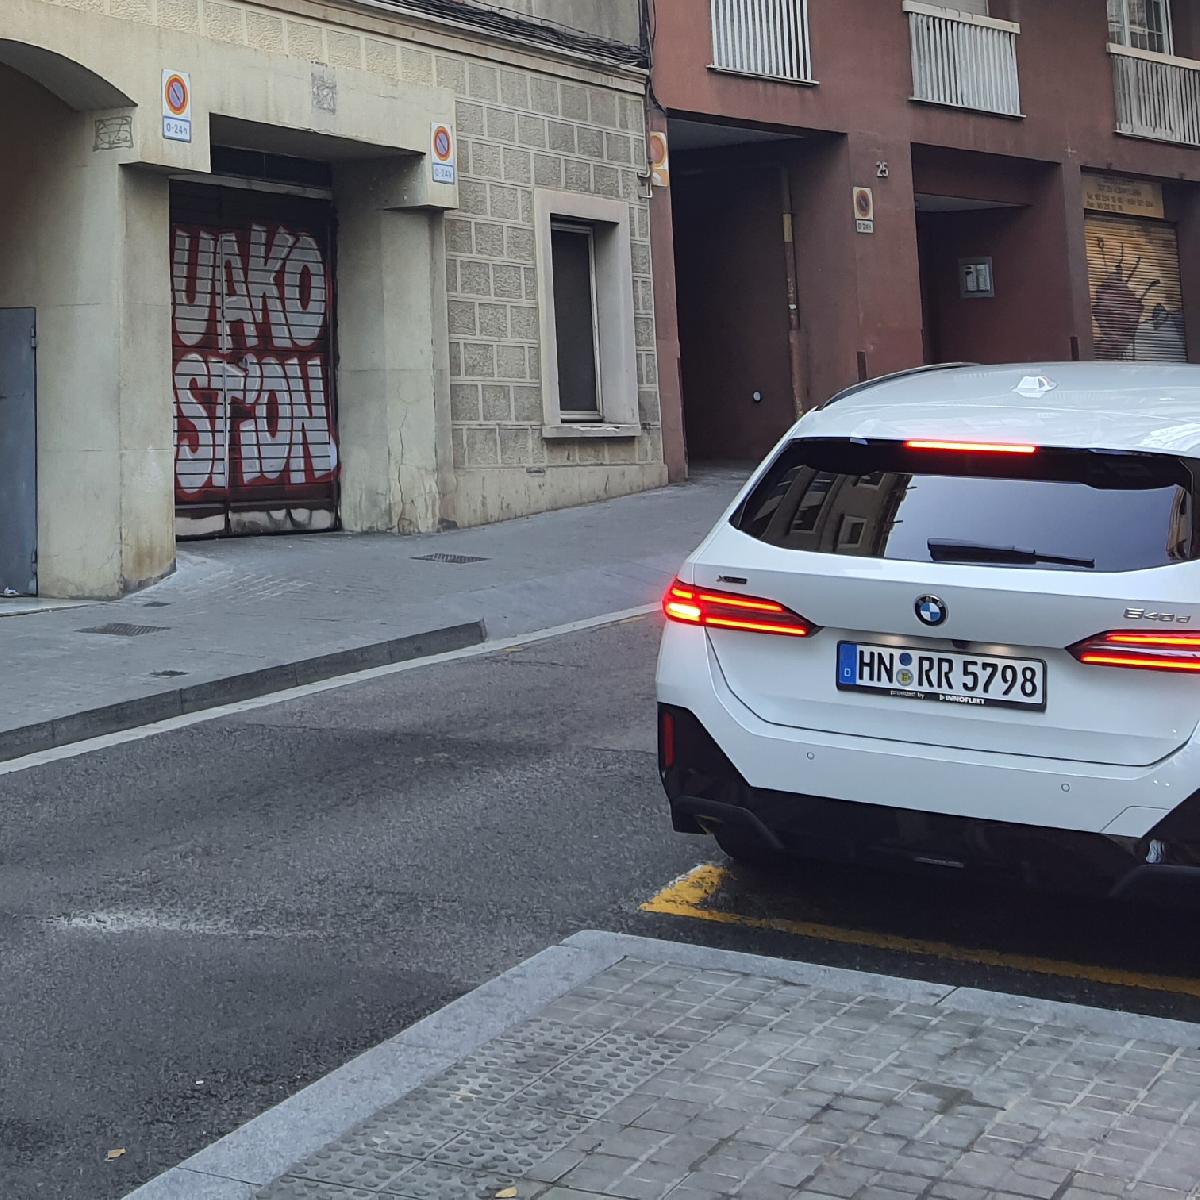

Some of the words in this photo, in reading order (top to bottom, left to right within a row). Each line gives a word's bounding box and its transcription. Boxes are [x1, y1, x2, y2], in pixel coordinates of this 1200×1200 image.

[875, 160, 889, 177] 25
[858, 650, 895, 684] HN
[918, 656, 954, 690] RR
[962, 660, 1038, 698] 5798
